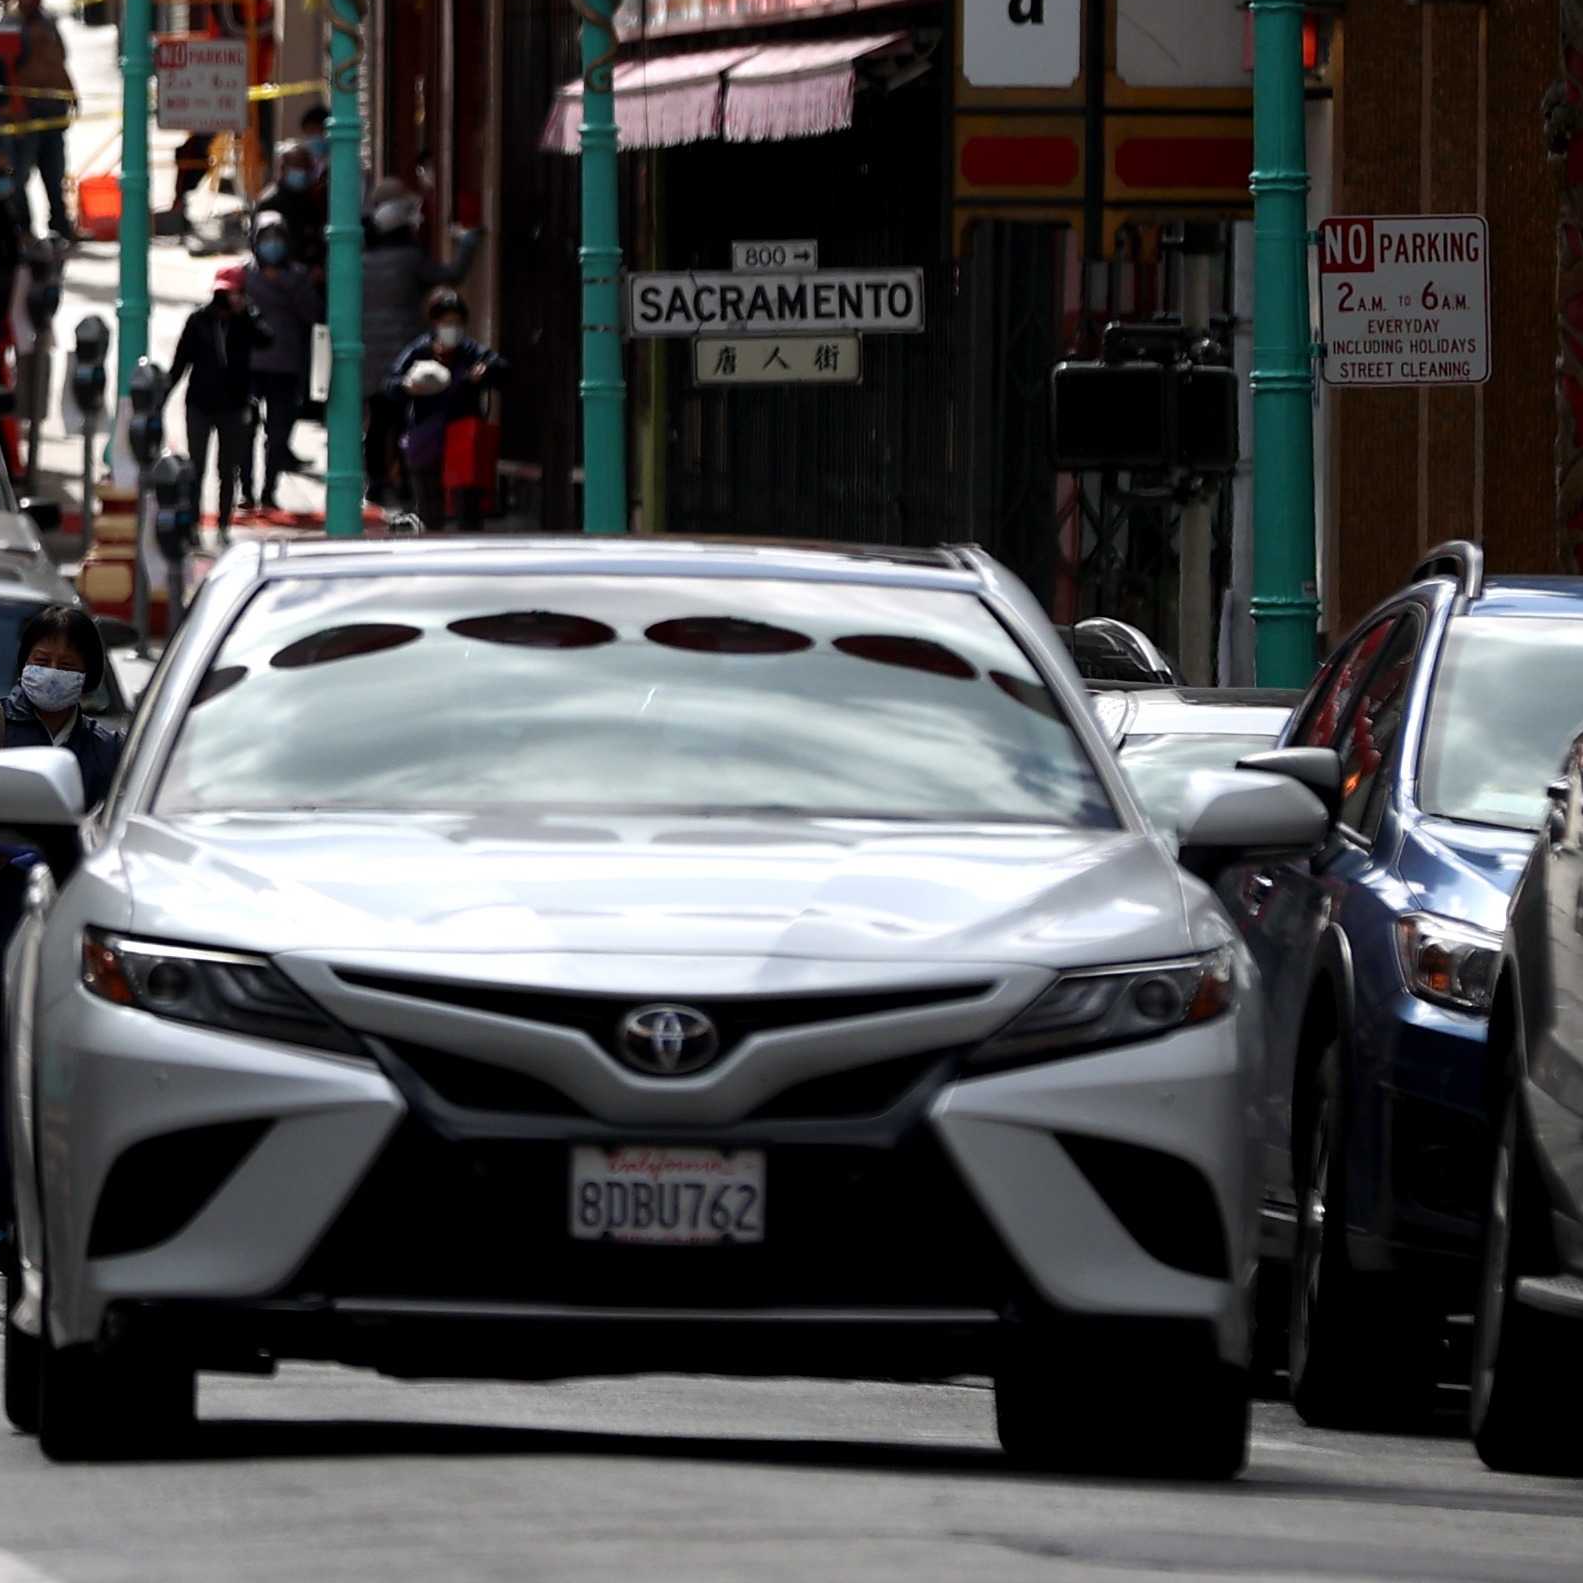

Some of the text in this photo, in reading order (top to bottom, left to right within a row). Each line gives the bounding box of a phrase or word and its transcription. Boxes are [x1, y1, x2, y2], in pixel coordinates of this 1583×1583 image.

[1324, 223, 1479, 265] NO PARKING
[745, 245, 787, 266] 800
[640, 282, 914, 323] SACRAMENTO
[1368, 319, 1440, 334] EVERYDAY
[1333, 338, 1476, 355] INCLUDING HOLIDAYS
[1340, 361, 1471, 378] STREET CLEANING
[580, 1181, 758, 1231] 8DBU762
